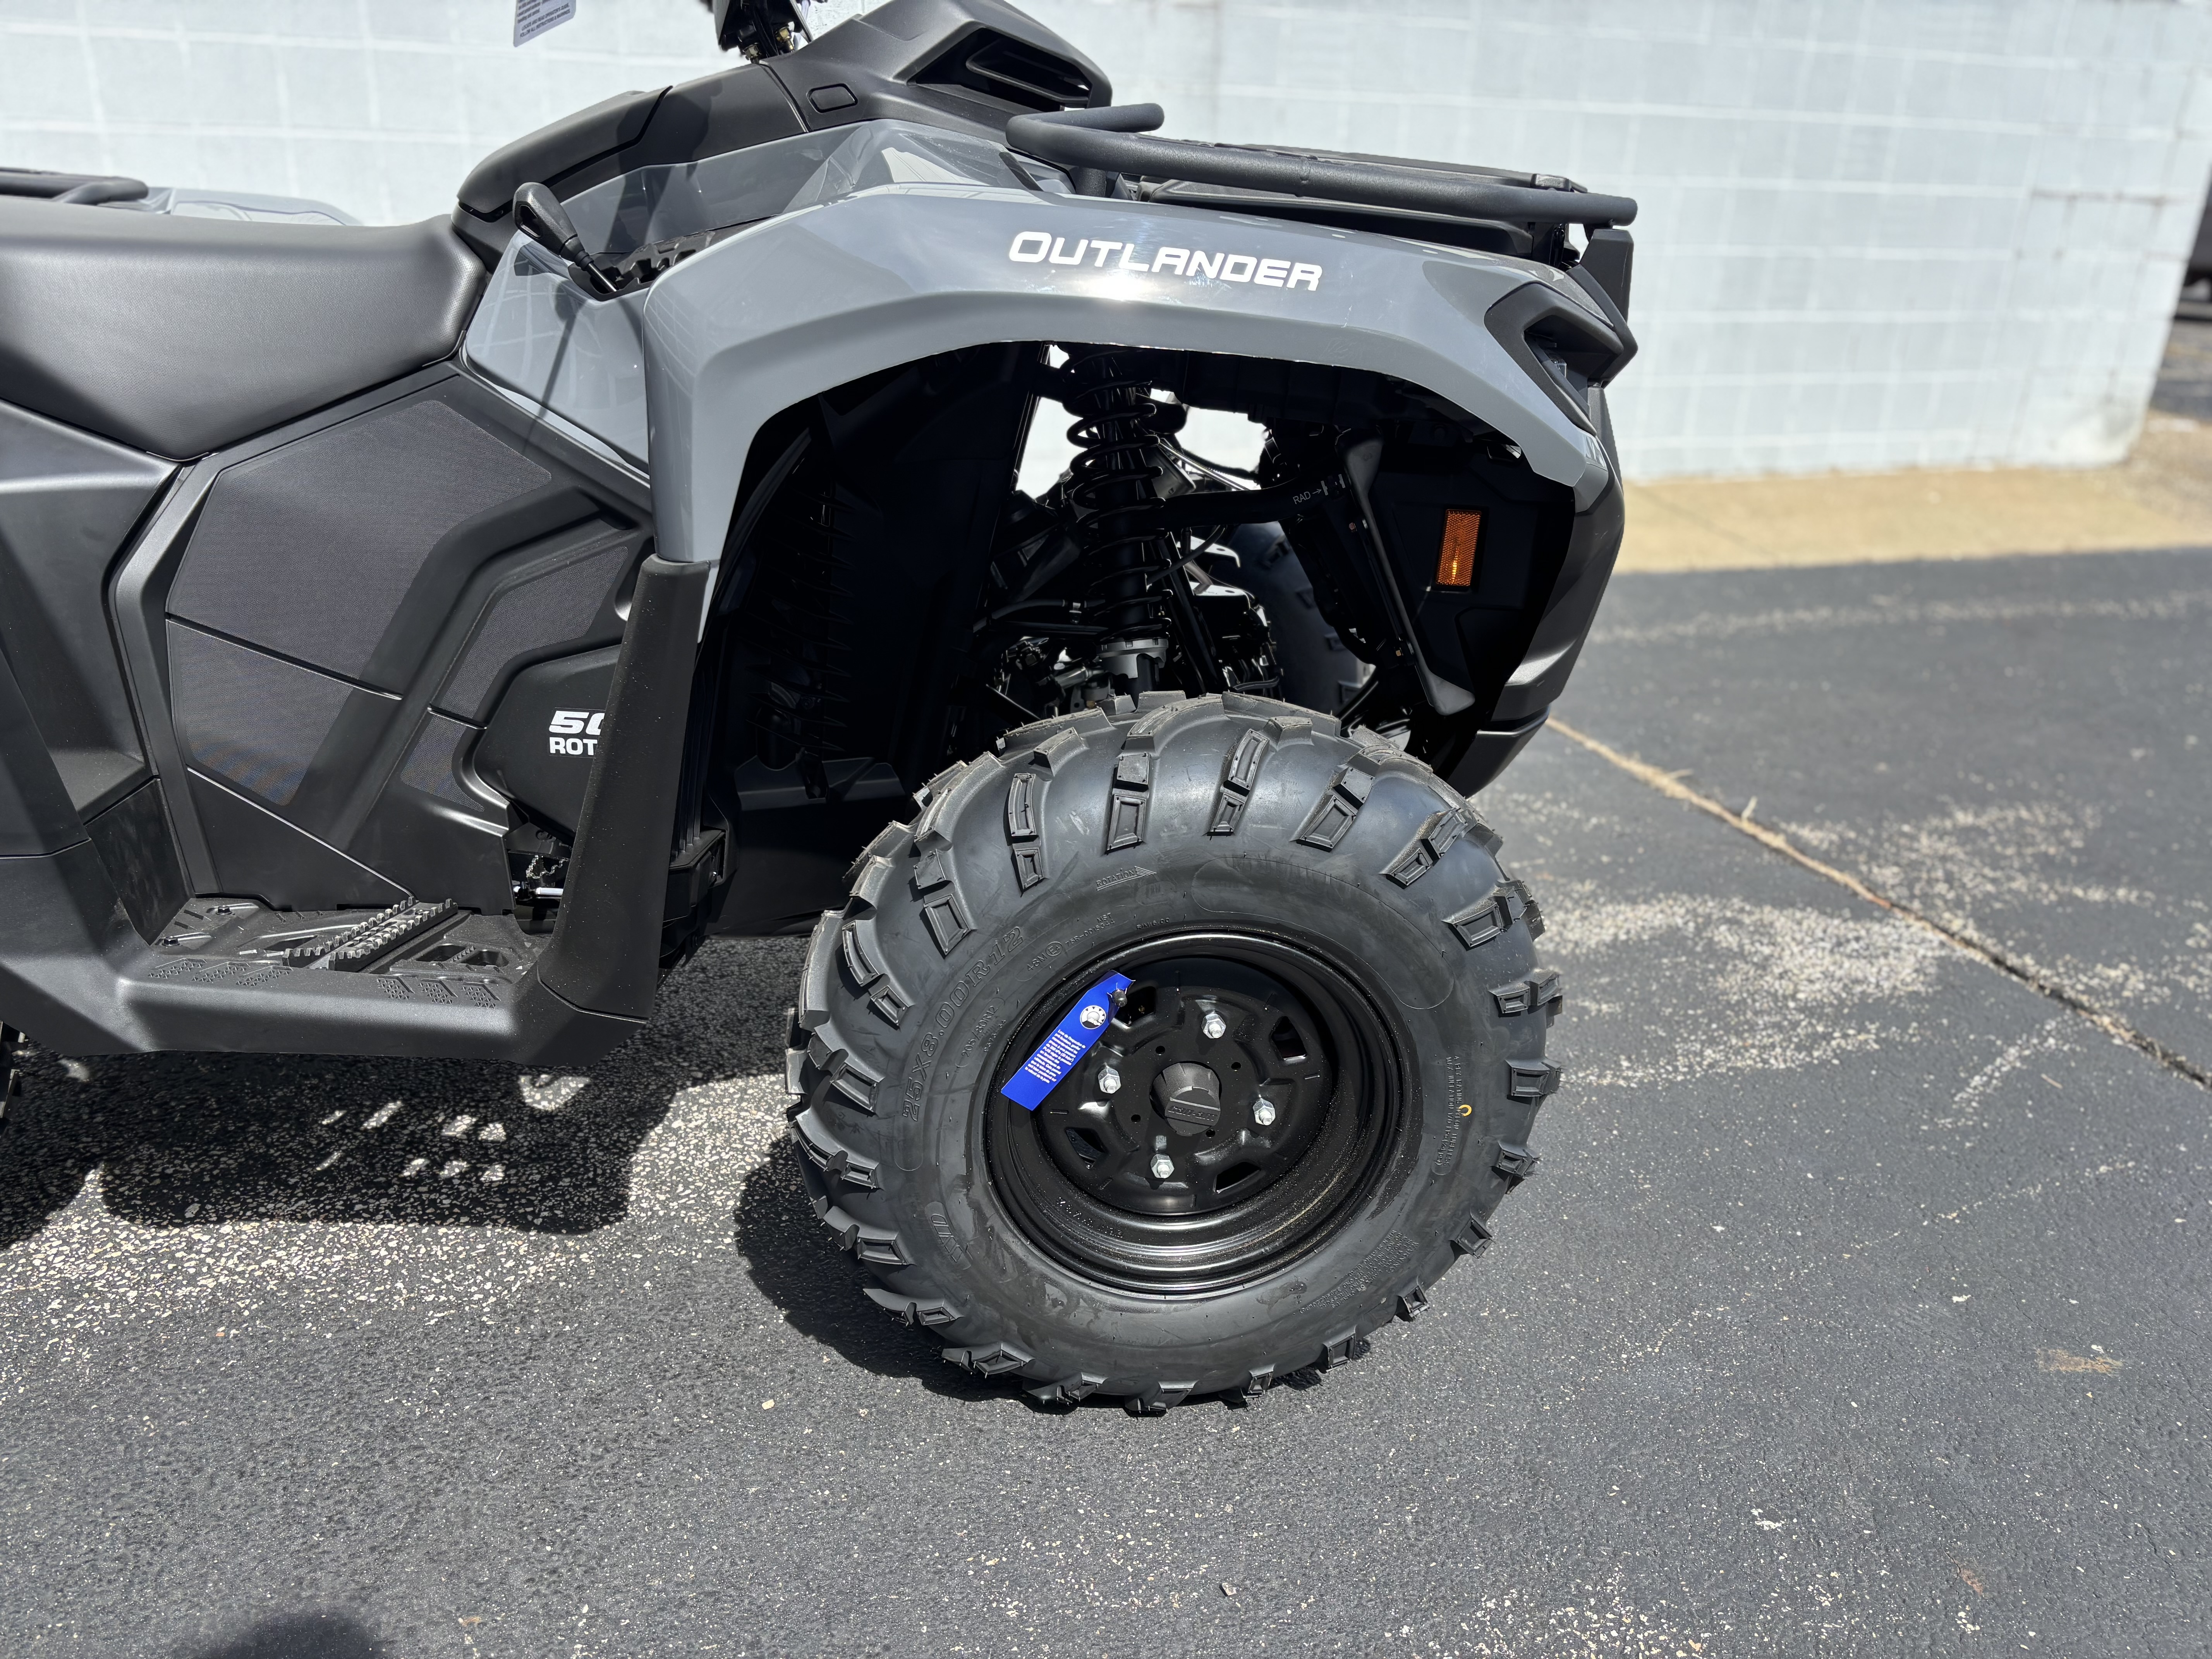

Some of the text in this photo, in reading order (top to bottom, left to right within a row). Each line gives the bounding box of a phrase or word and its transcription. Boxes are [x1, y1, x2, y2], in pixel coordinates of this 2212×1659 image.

[1008, 231, 1322, 291] OUTLANDER
[1292, 491, 1311, 504] RAD
[1096, 869, 1135, 887] ROTATION
[1096, 912, 1112, 924] MST
[1027, 953, 1048, 972] 48M
[902, 926, 1024, 1121] 25X8.00R12
[962, 1006, 998, 1058] 205/80R12
